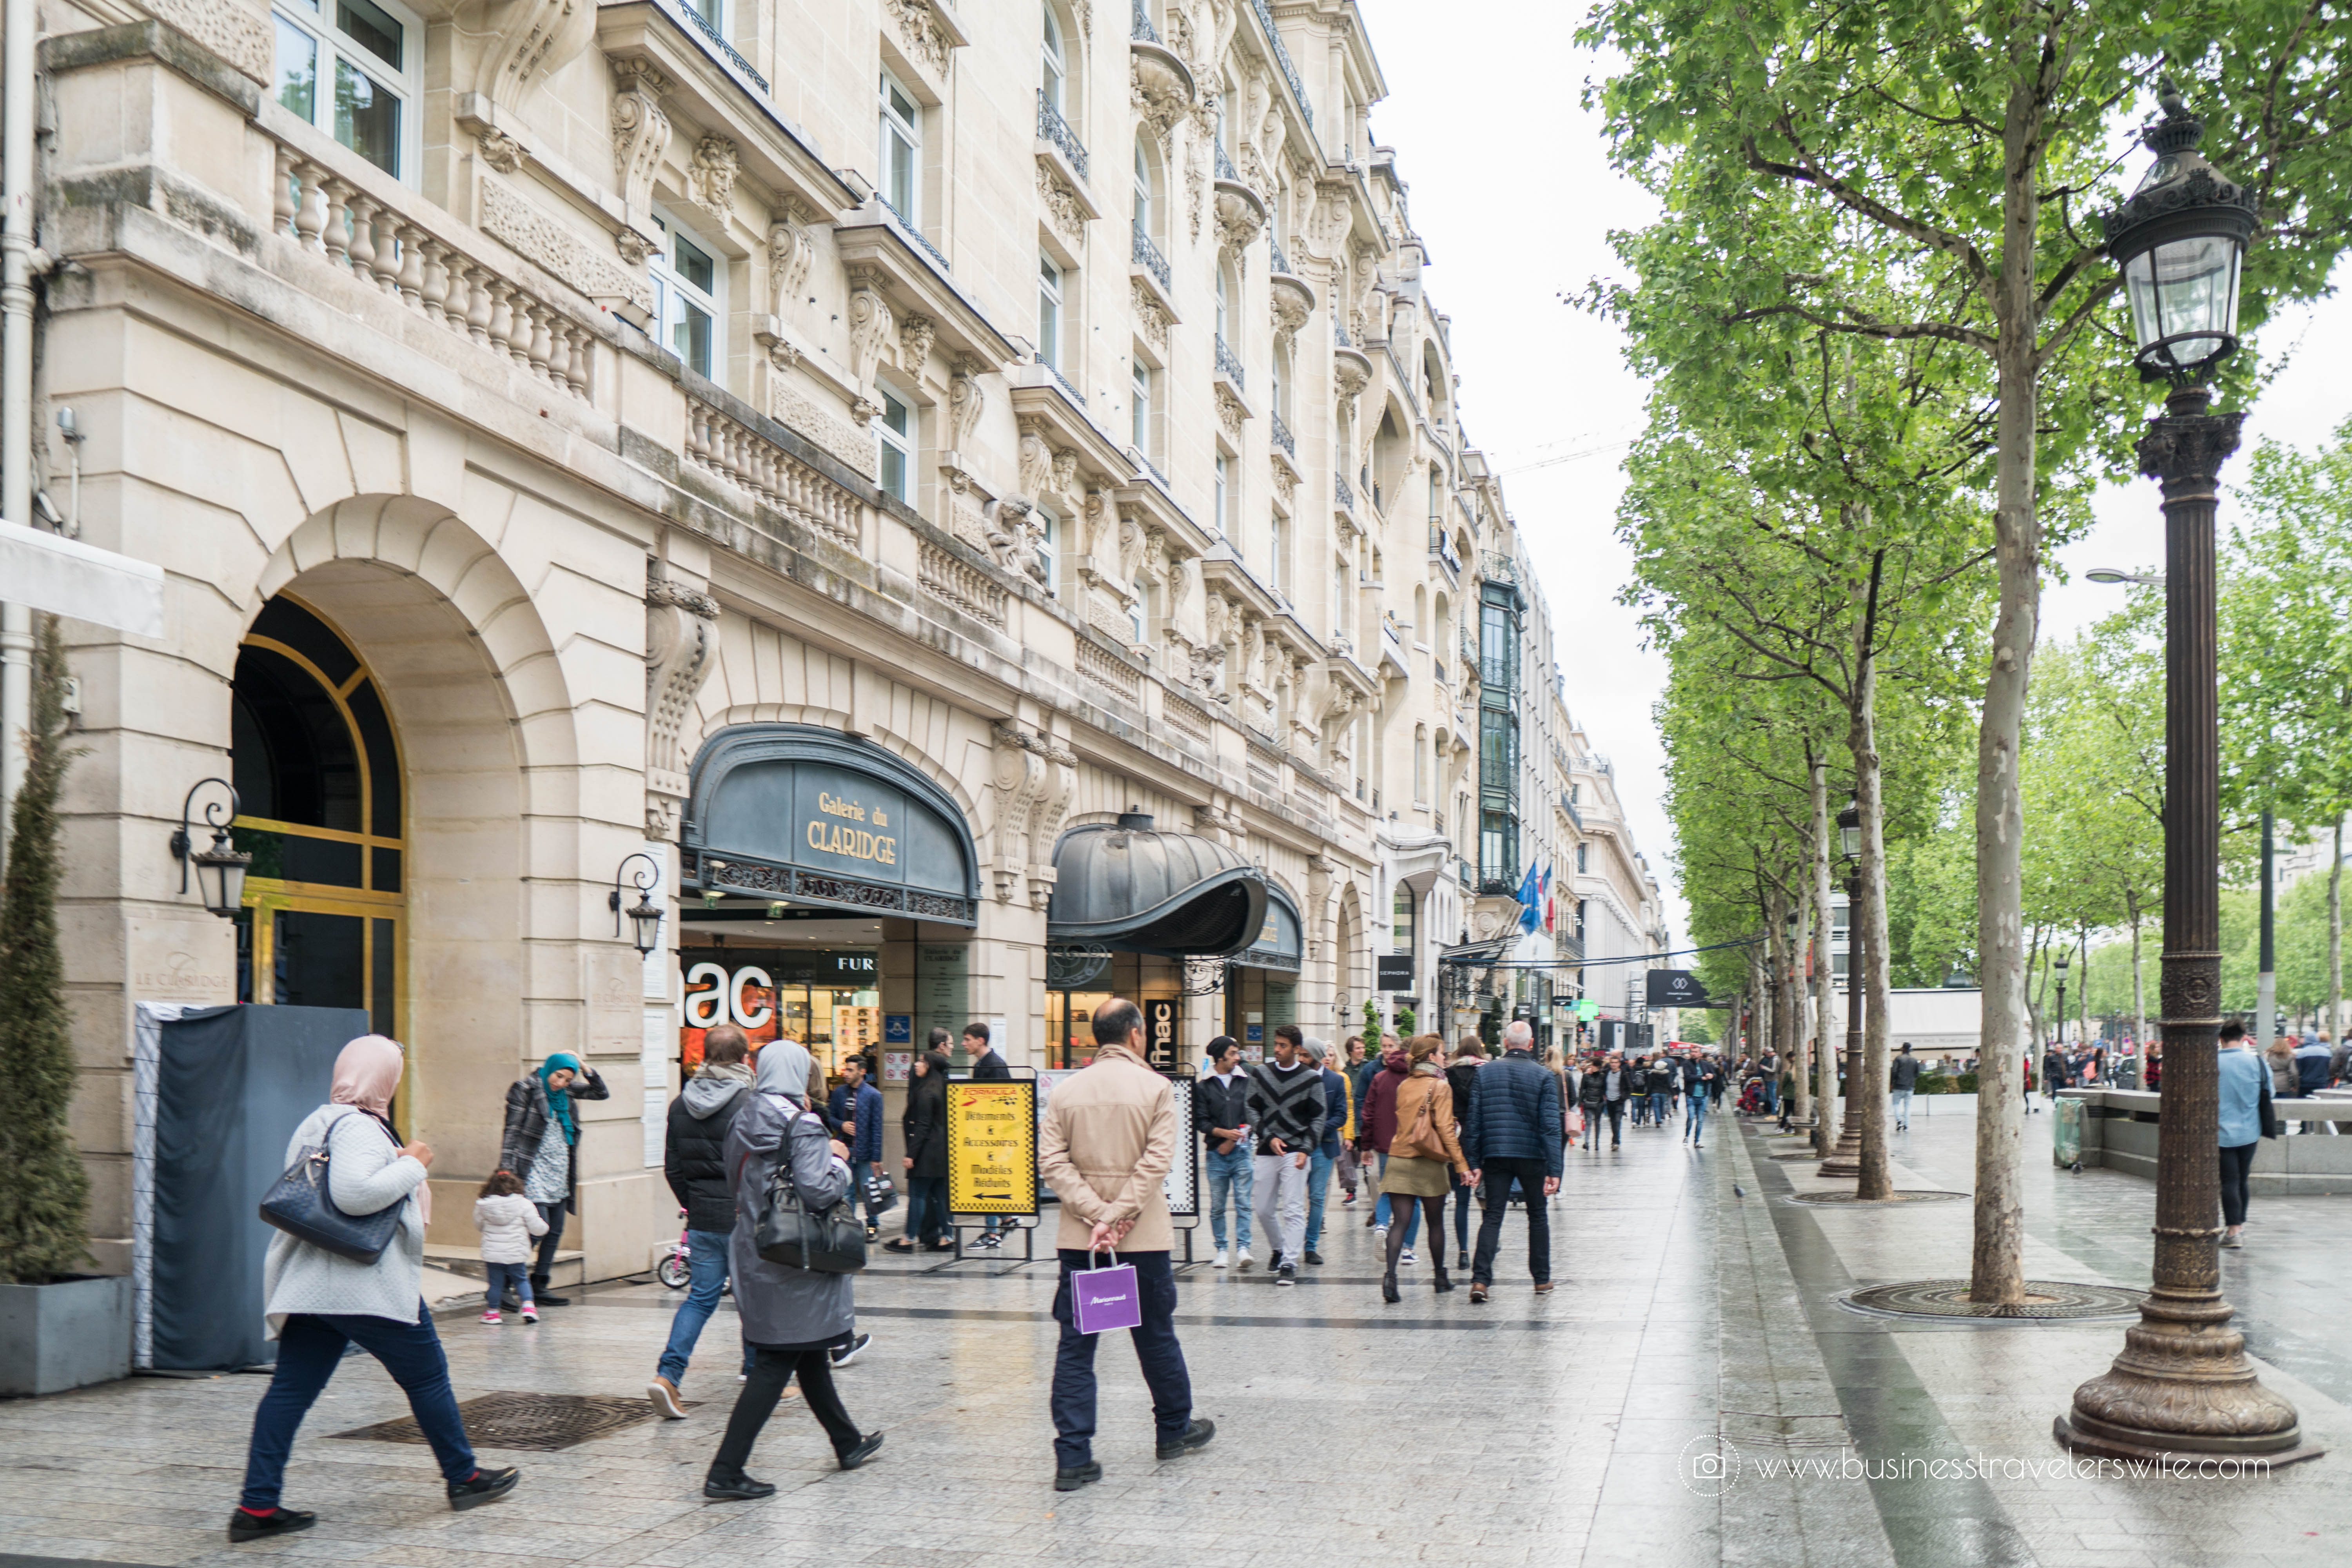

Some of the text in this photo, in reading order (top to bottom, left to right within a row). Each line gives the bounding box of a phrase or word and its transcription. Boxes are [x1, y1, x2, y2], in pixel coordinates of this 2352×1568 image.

[818, 792, 888, 827] Galerie du
[807, 820, 896, 865] CLARIDGE
[135, 972, 151, 985] LE
[1150, 1003, 1172, 1068] fnac
[965, 1111, 1015, 1121] Vêtements
[964, 1137, 1019, 1147] Accessoires
[971, 1165, 1013, 1174] Modèles
[973, 1178, 1011, 1187] Réduits
